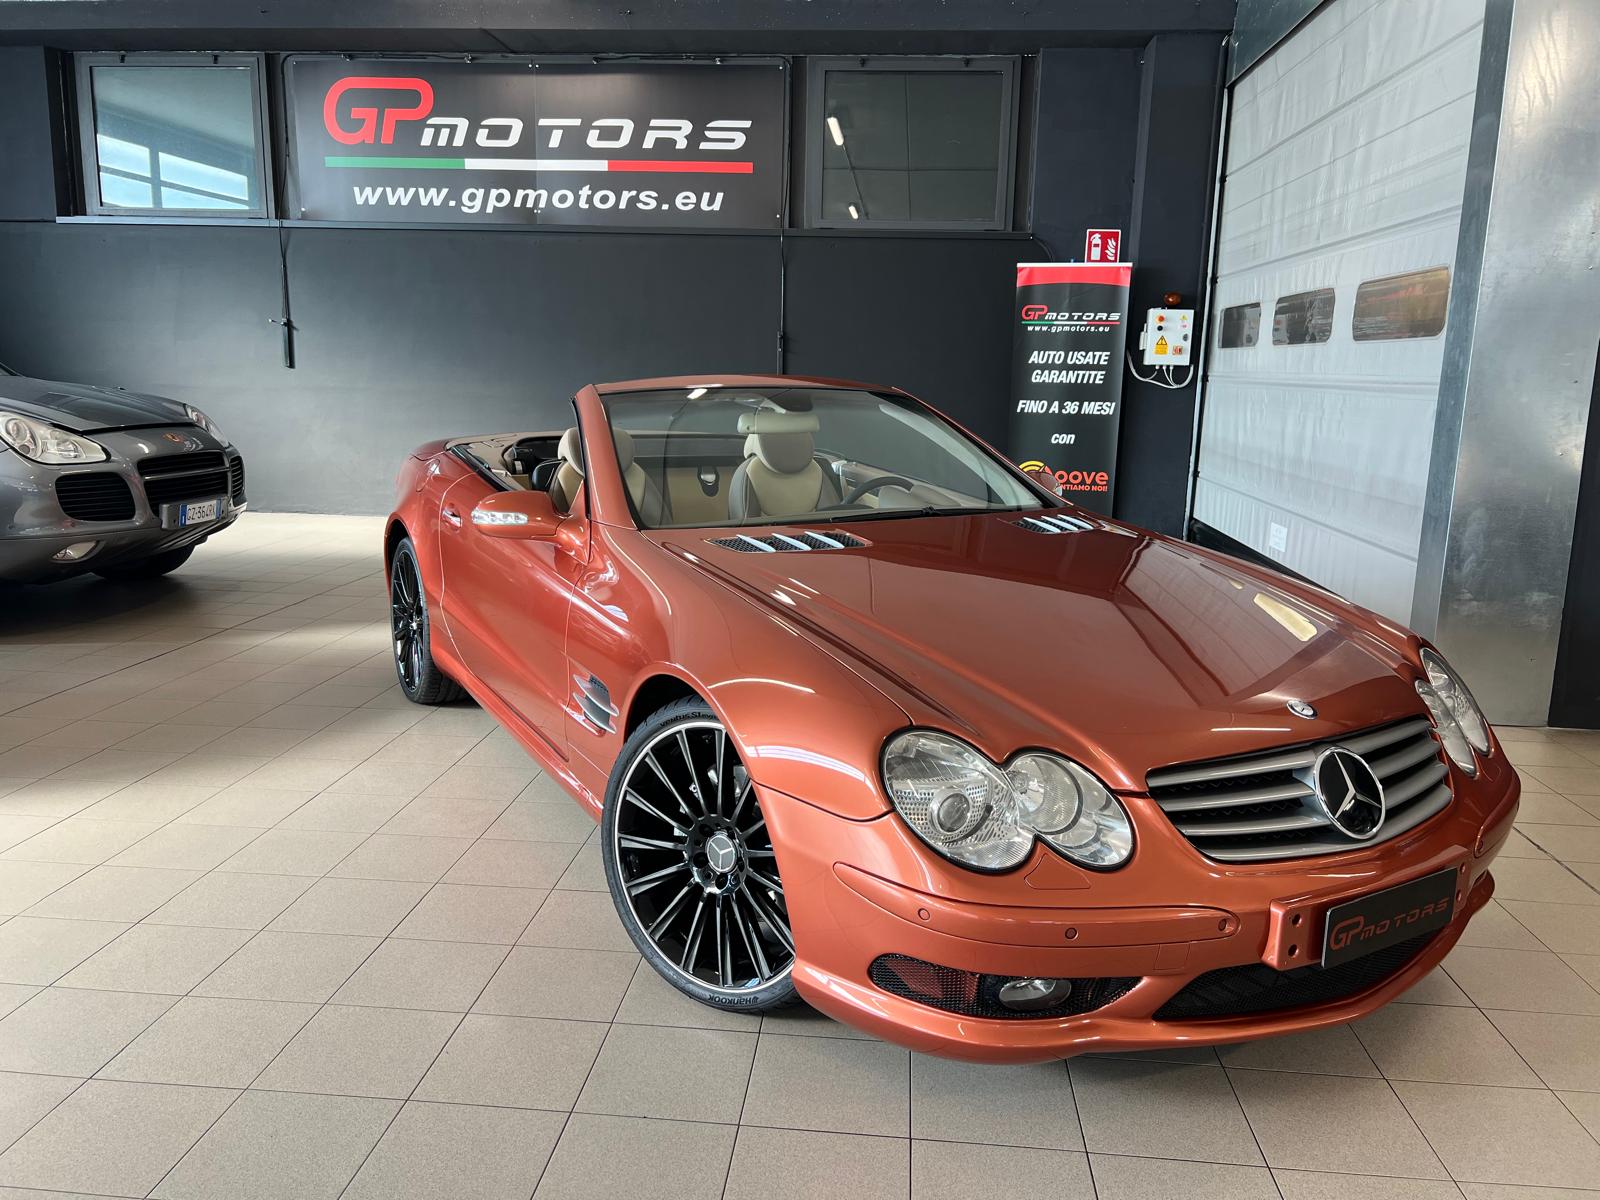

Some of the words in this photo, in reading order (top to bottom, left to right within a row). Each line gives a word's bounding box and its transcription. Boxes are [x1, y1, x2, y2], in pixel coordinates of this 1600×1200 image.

[353, 184, 724, 214] www.gpmotors.eu
[1027, 325, 1110, 333] www.gpmotors.eu
[1028, 350, 1065, 364] AUTO
[1066, 351, 1110, 365] USATE
[1031, 369, 1106, 384] GARANTITE
[1016, 399, 1048, 413] FINO
[1048, 400, 1060, 414] A
[1061, 401, 1080, 415] 36
[1080, 402, 1116, 415] MESI
[1051, 433, 1076, 444] con
